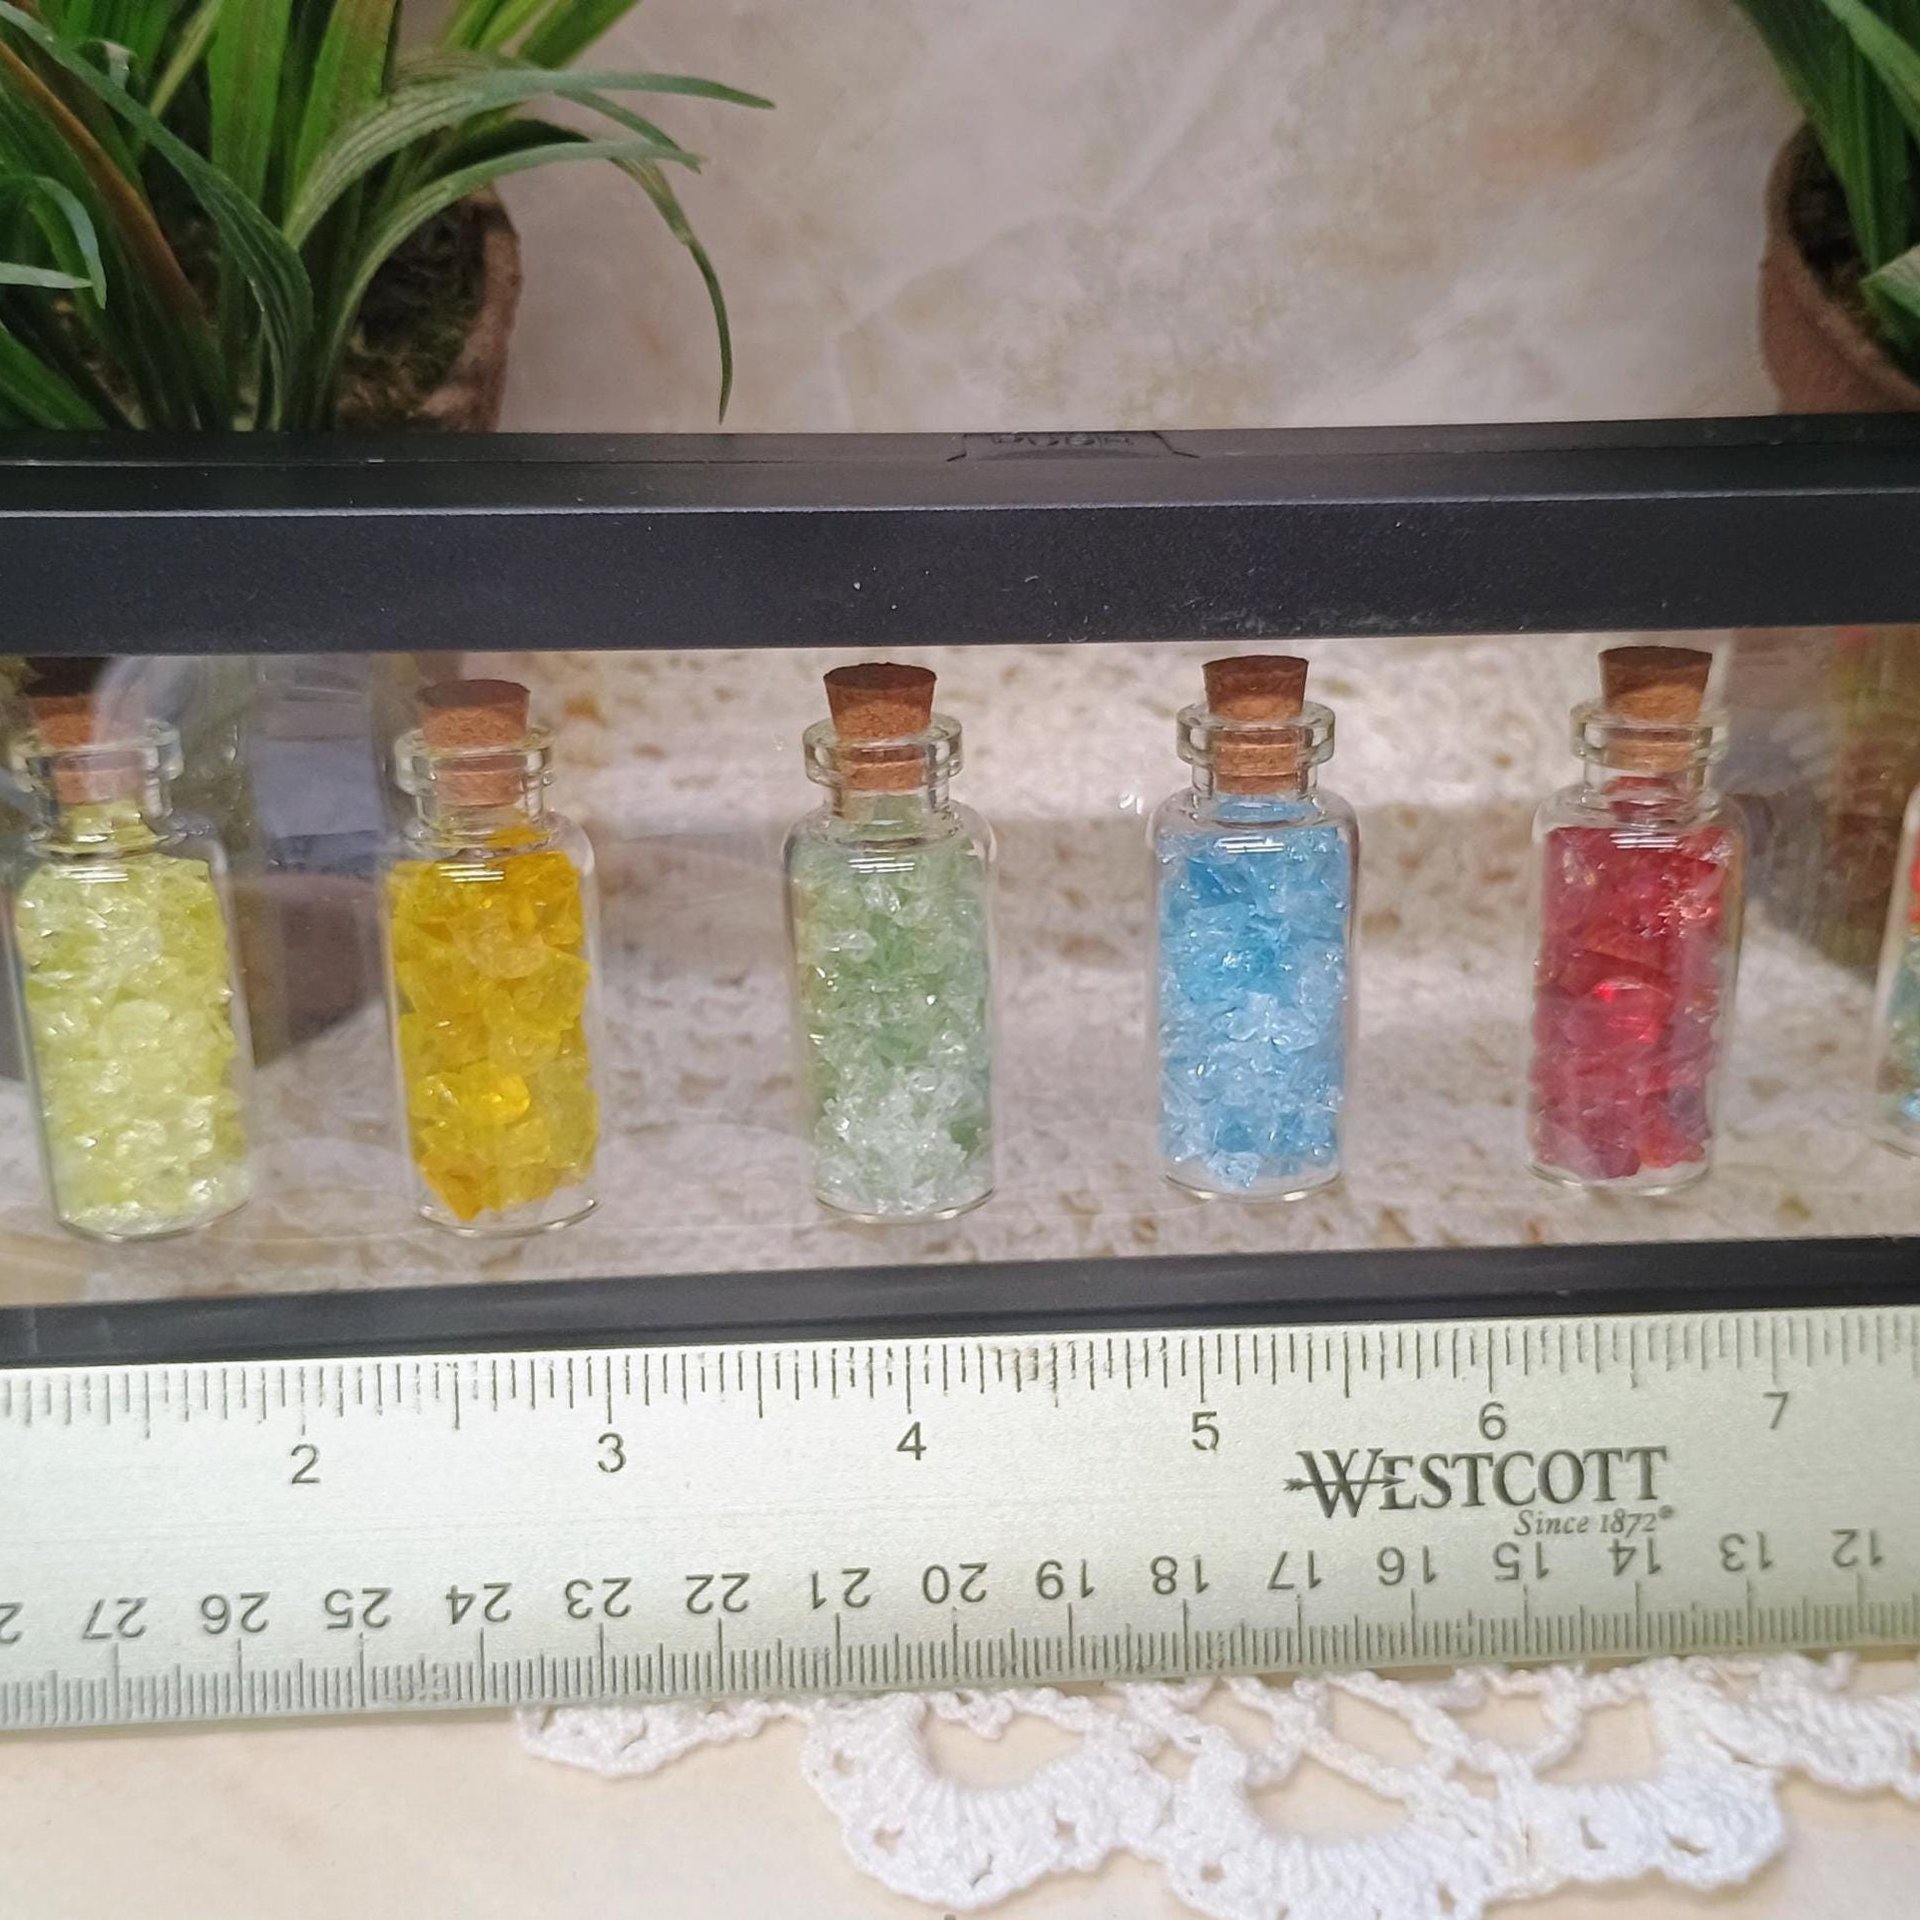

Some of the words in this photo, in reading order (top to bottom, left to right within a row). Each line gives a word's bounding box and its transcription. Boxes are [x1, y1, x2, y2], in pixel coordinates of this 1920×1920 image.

[1191, 1410, 1220, 1452] 5
[1478, 1401, 1509, 1442] 6
[1763, 1391, 1790, 1431] 7
[597, 1431, 627, 1474] 3
[895, 1421, 928, 1462] 4
[289, 1443, 321, 1486] 2
[1290, 1445, 1668, 1519] WESTCOTT
[1513, 1508, 1590, 1537] Since
[1266, 1549, 1323, 1591] 17
[1376, 1545, 1438, 1587] 16
[1492, 1541, 1550, 1582] 15
[1608, 1537, 1662, 1577] 14
[1718, 1530, 1773, 1573] 13
[1831, 1528, 1884, 1569] 12
[684, 1572, 751, 1616] 22
[809, 1566, 872, 1611] 21
[921, 1562, 989, 1605] 20
[1035, 1558, 1096, 1601] 19
[1149, 1554, 1211, 1596] 18
[81, 1596, 148, 1641] 27
[198, 1591, 271, 1636] 26
[323, 1587, 393, 1631] 25
[444, 1582, 513, 1626] 24
[563, 1576, 633, 1621] 23
[0, 1602, 24, 1646] 2
